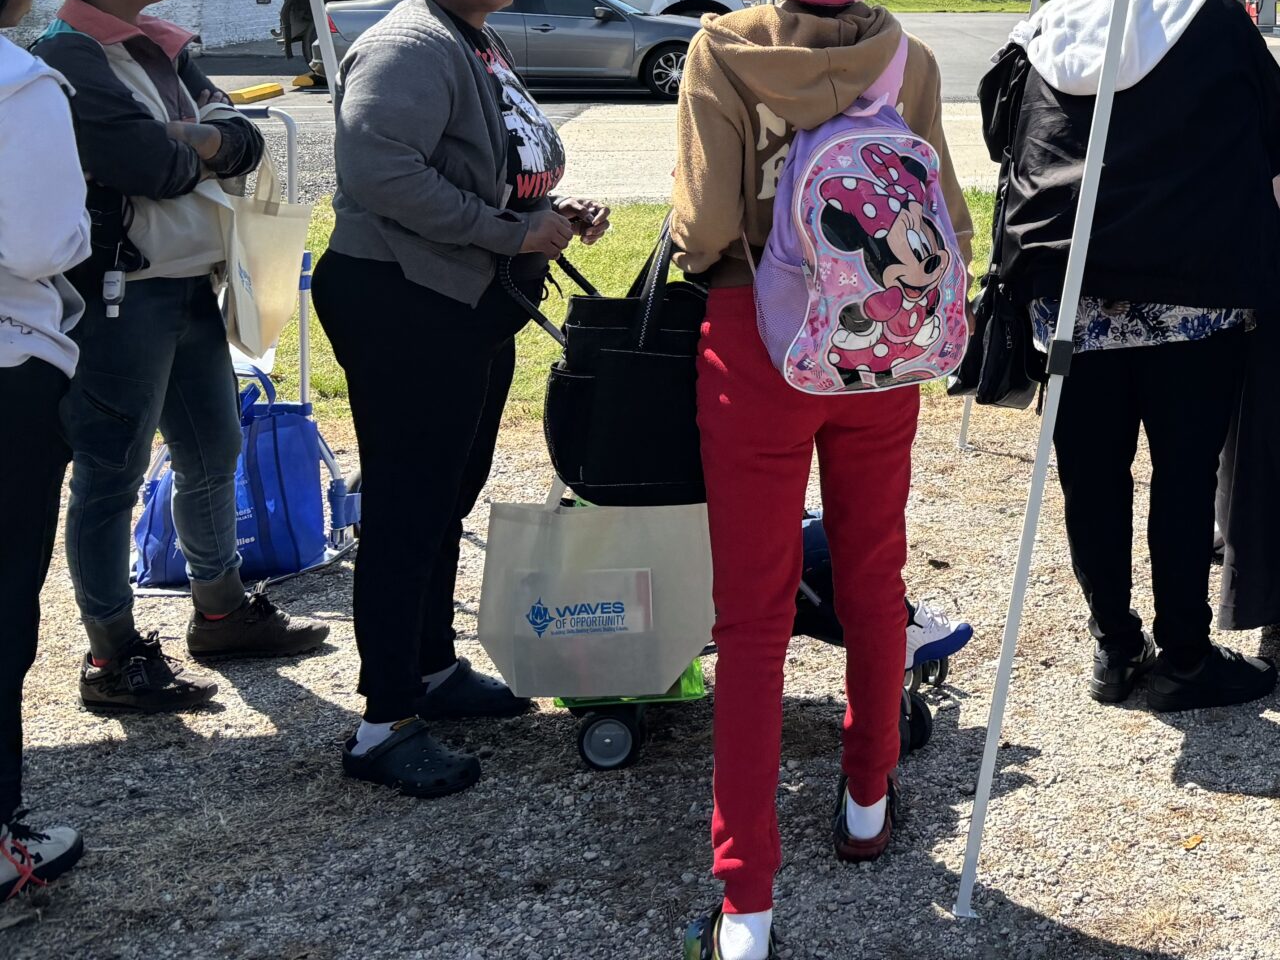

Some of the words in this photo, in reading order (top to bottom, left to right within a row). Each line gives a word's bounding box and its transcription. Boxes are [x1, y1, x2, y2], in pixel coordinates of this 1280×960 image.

[555, 601, 625, 617] WAVES
[555, 619, 567, 629] OF
[570, 614, 626, 628] OPPORTUNITY
